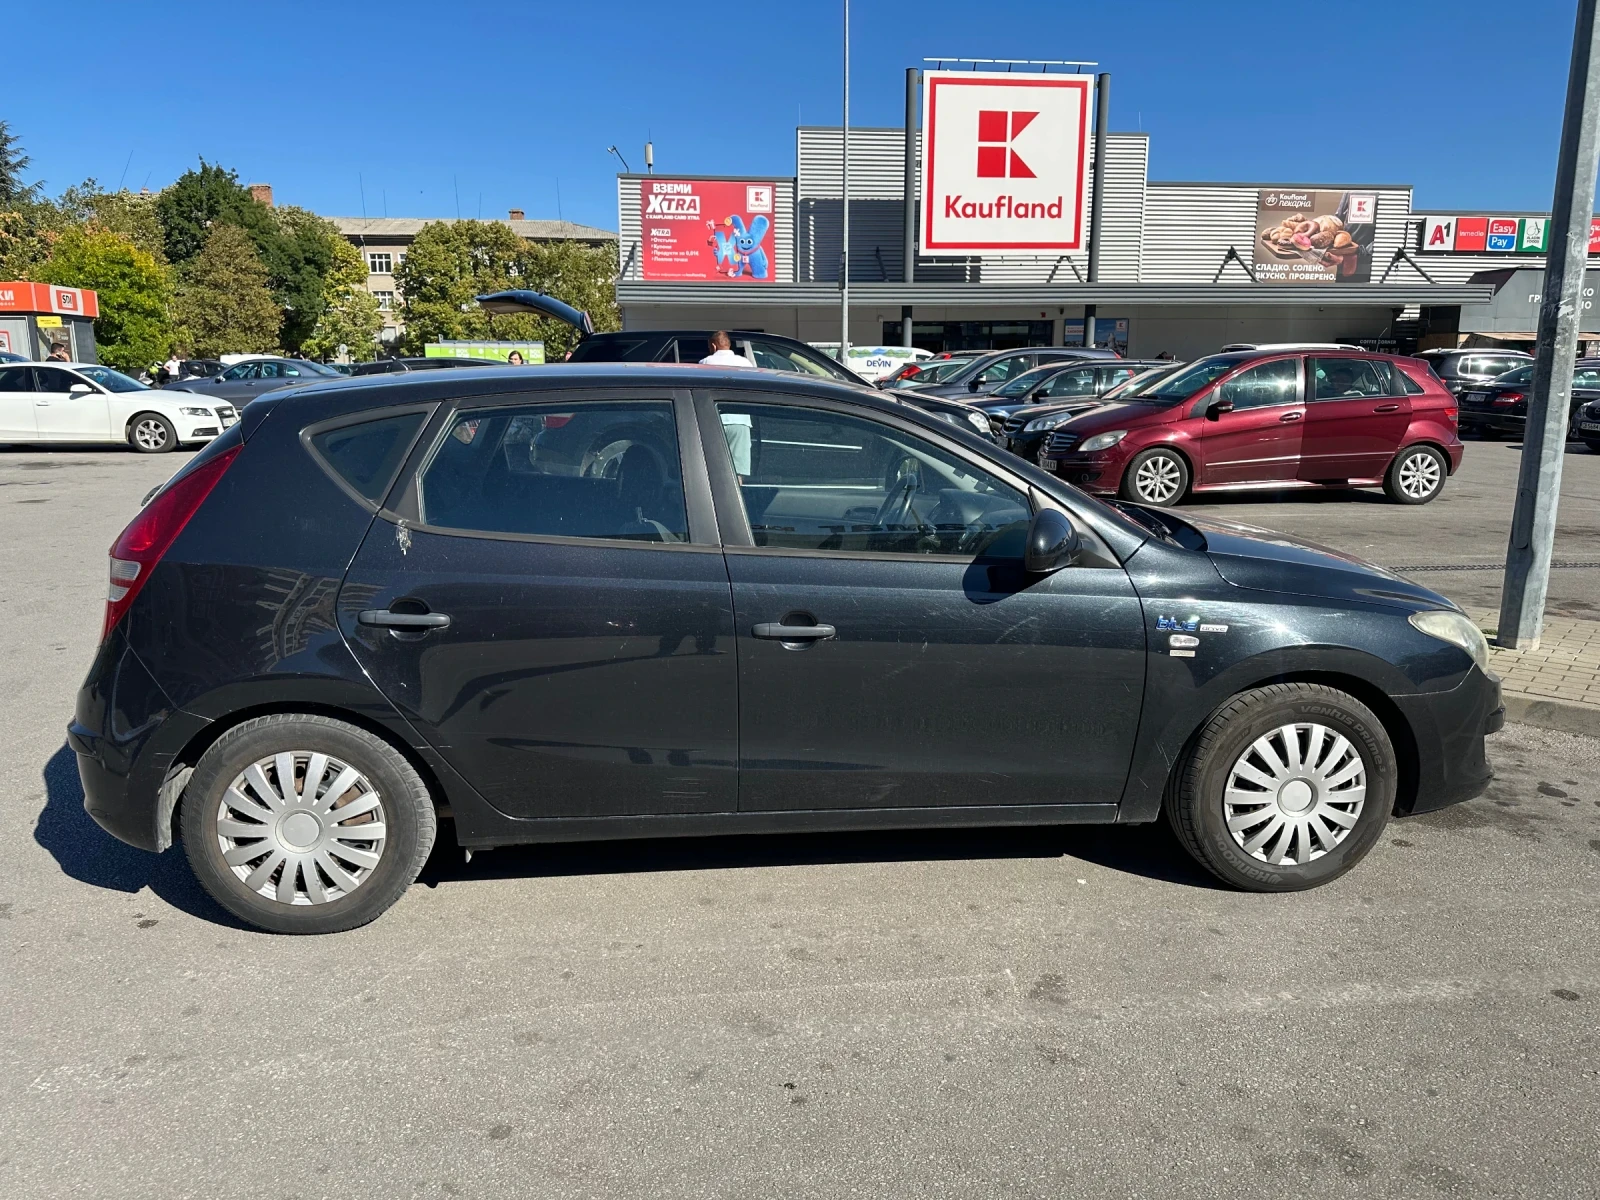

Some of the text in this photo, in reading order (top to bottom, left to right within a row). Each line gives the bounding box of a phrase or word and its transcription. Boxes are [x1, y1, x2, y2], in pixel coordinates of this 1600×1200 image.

[653, 183, 692, 194] ВЗЕМИ
[1279, 193, 1308, 201] Kaufland
[646, 194, 700, 214] XTRA
[944, 194, 1063, 219] Kaufland
[1428, 222, 1452, 246] A1
[1459, 229, 1485, 237] inmedio
[1492, 223, 1515, 235] Easy
[1491, 237, 1509, 249] Pay
[1255, 263, 1326, 272] СЛАДКО. СОЛЕНО.
[1255, 272, 1337, 281] ВКУСНО. ПРОВЕРЕНО.
[866, 359, 892, 368] DEVIN
[1156, 615, 1198, 632] blue
